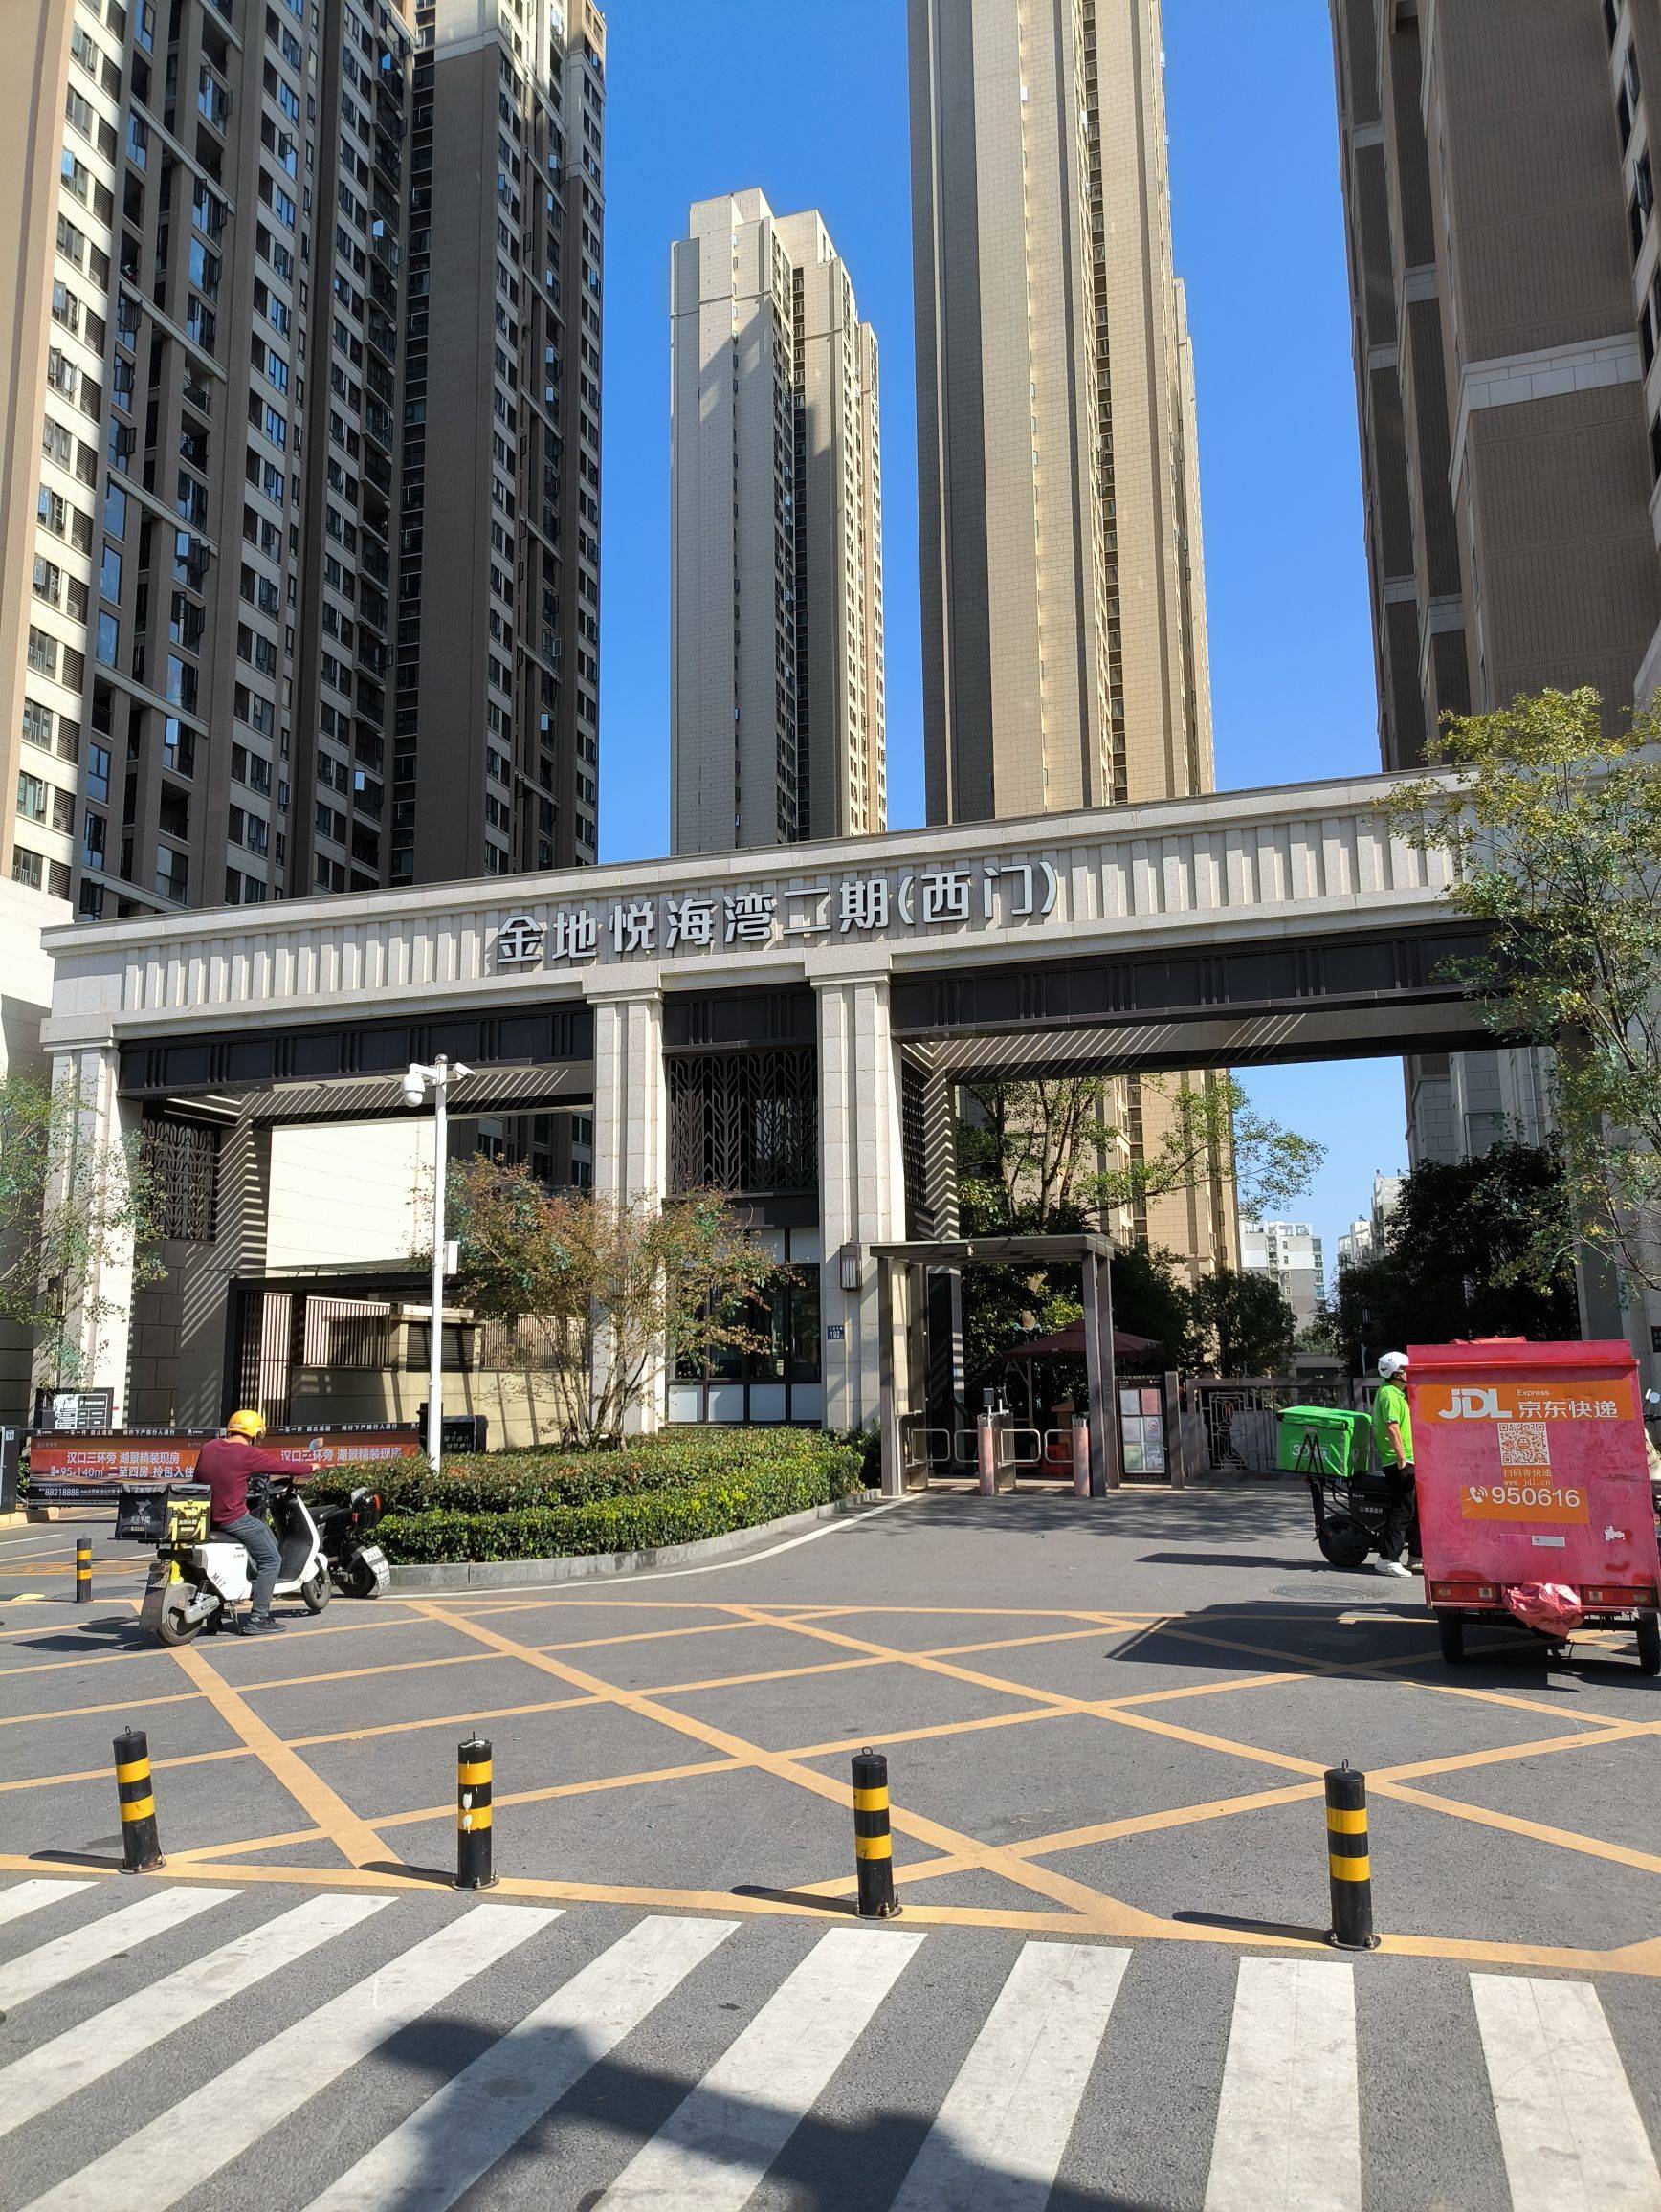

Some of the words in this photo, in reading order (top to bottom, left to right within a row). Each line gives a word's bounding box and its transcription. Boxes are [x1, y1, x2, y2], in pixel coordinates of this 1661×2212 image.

[1438, 1388, 1513, 1419] JDL
[1518, 1400, 1618, 1419] 京东快递
[67, 1451, 116, 1464] 汉口三环旁
[1503, 1468, 1553, 1477] 扫码寄快递
[1491, 1486, 1581, 1508] 950616
